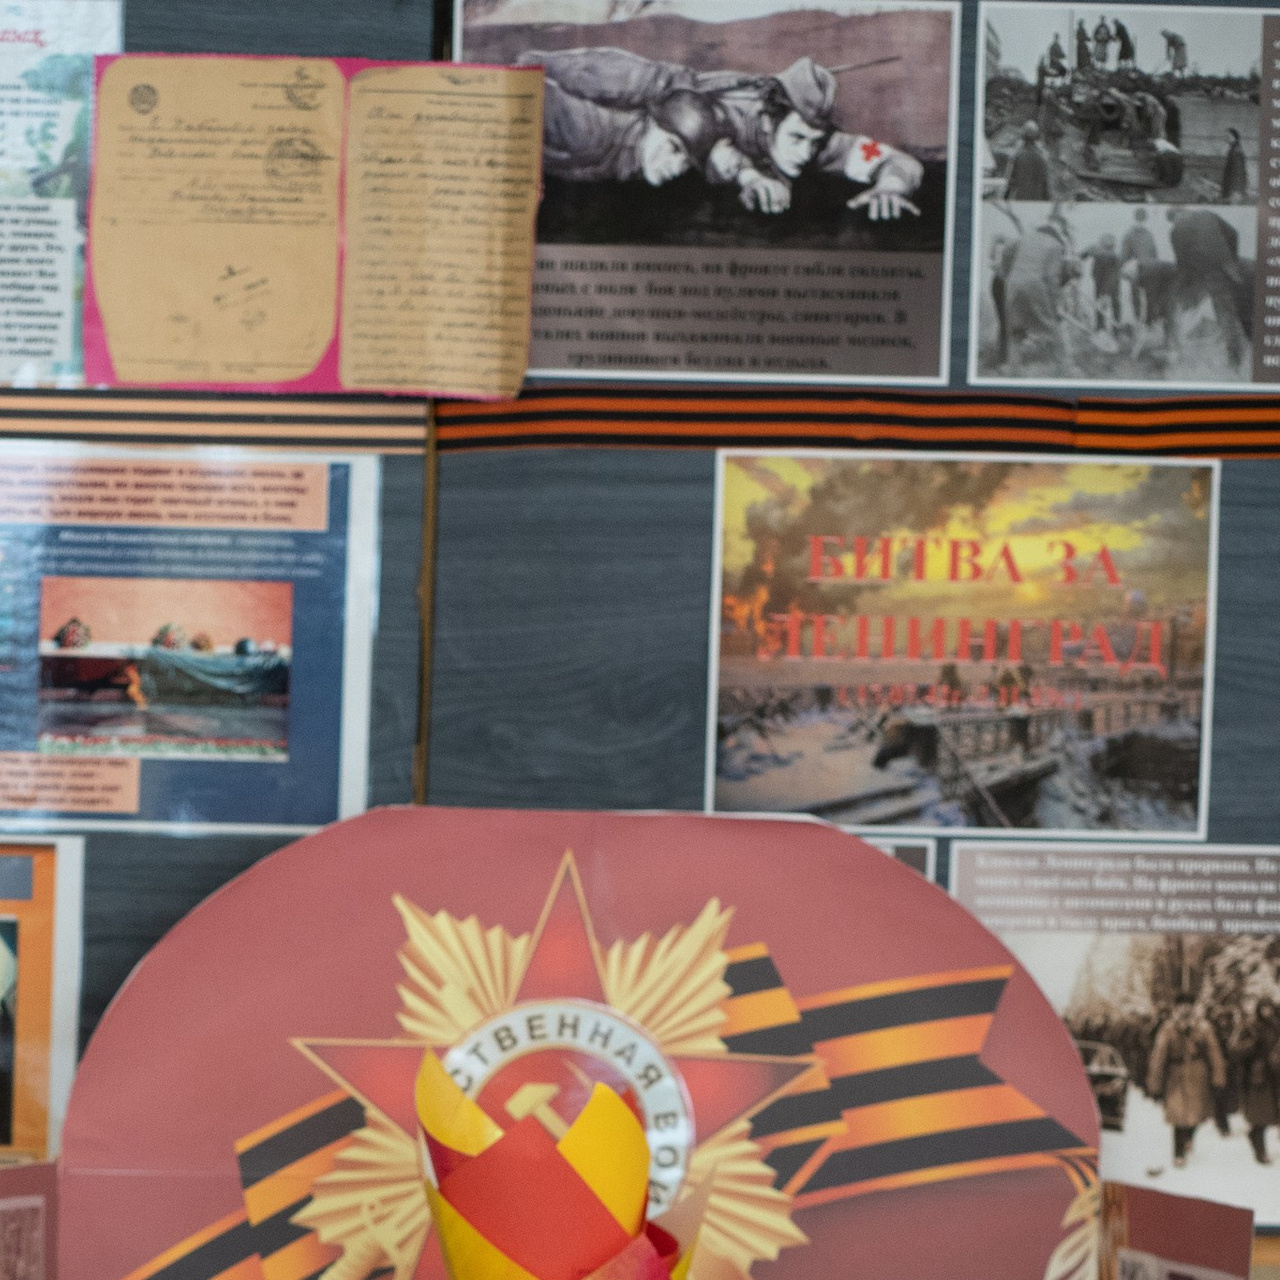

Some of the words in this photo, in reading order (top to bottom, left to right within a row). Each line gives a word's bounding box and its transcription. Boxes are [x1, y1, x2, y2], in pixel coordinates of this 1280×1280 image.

[806, 535, 1024, 586] БИТВА
[1047, 539, 1123, 590] ЗА
[756, 611, 1168, 679] ЛЕНИНГРАД
[449, 1012, 664, 1094] СТВЕННАЯ
